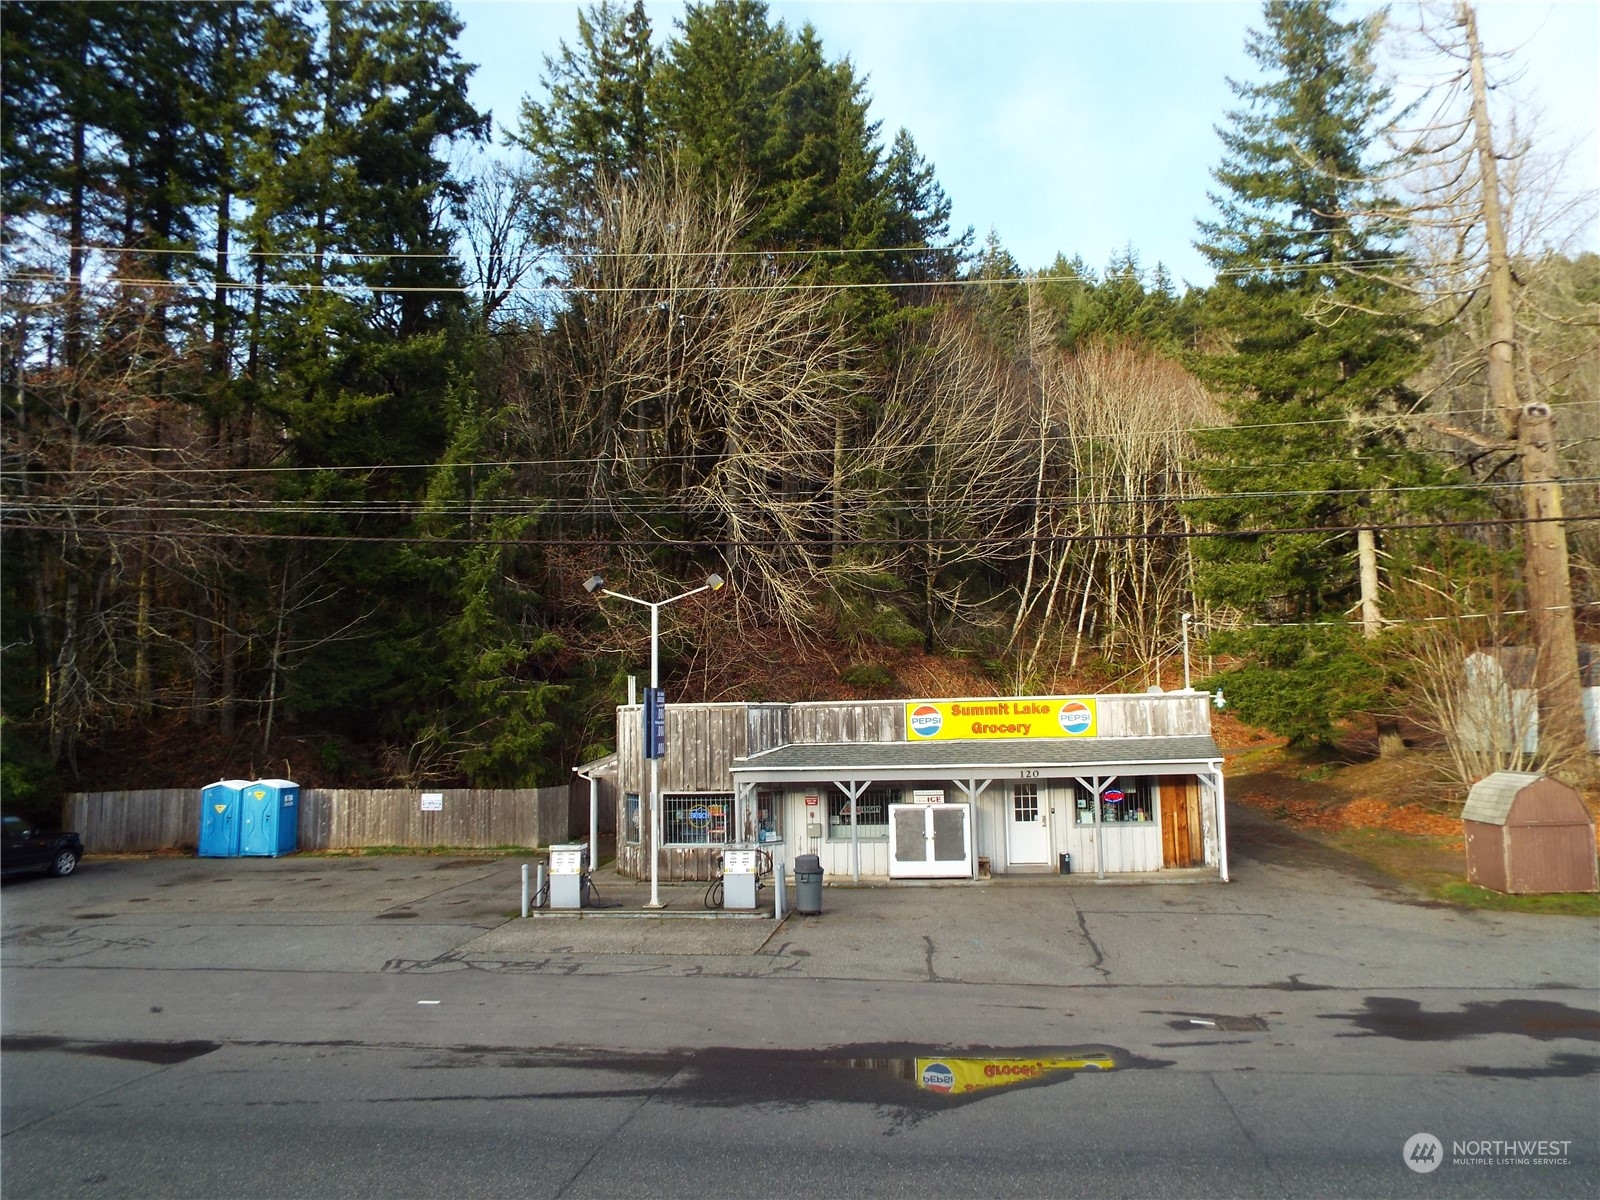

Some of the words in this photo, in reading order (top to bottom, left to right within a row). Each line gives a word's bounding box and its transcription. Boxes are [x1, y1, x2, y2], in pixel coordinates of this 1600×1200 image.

[951, 703, 1010, 717] Summit
[1013, 702, 1051, 715] Lake
[912, 717, 941, 725] PEPSI
[1060, 714, 1091, 722] PEPSI
[971, 721, 1032, 735] Grocery
[1020, 769, 1040, 779] 120
